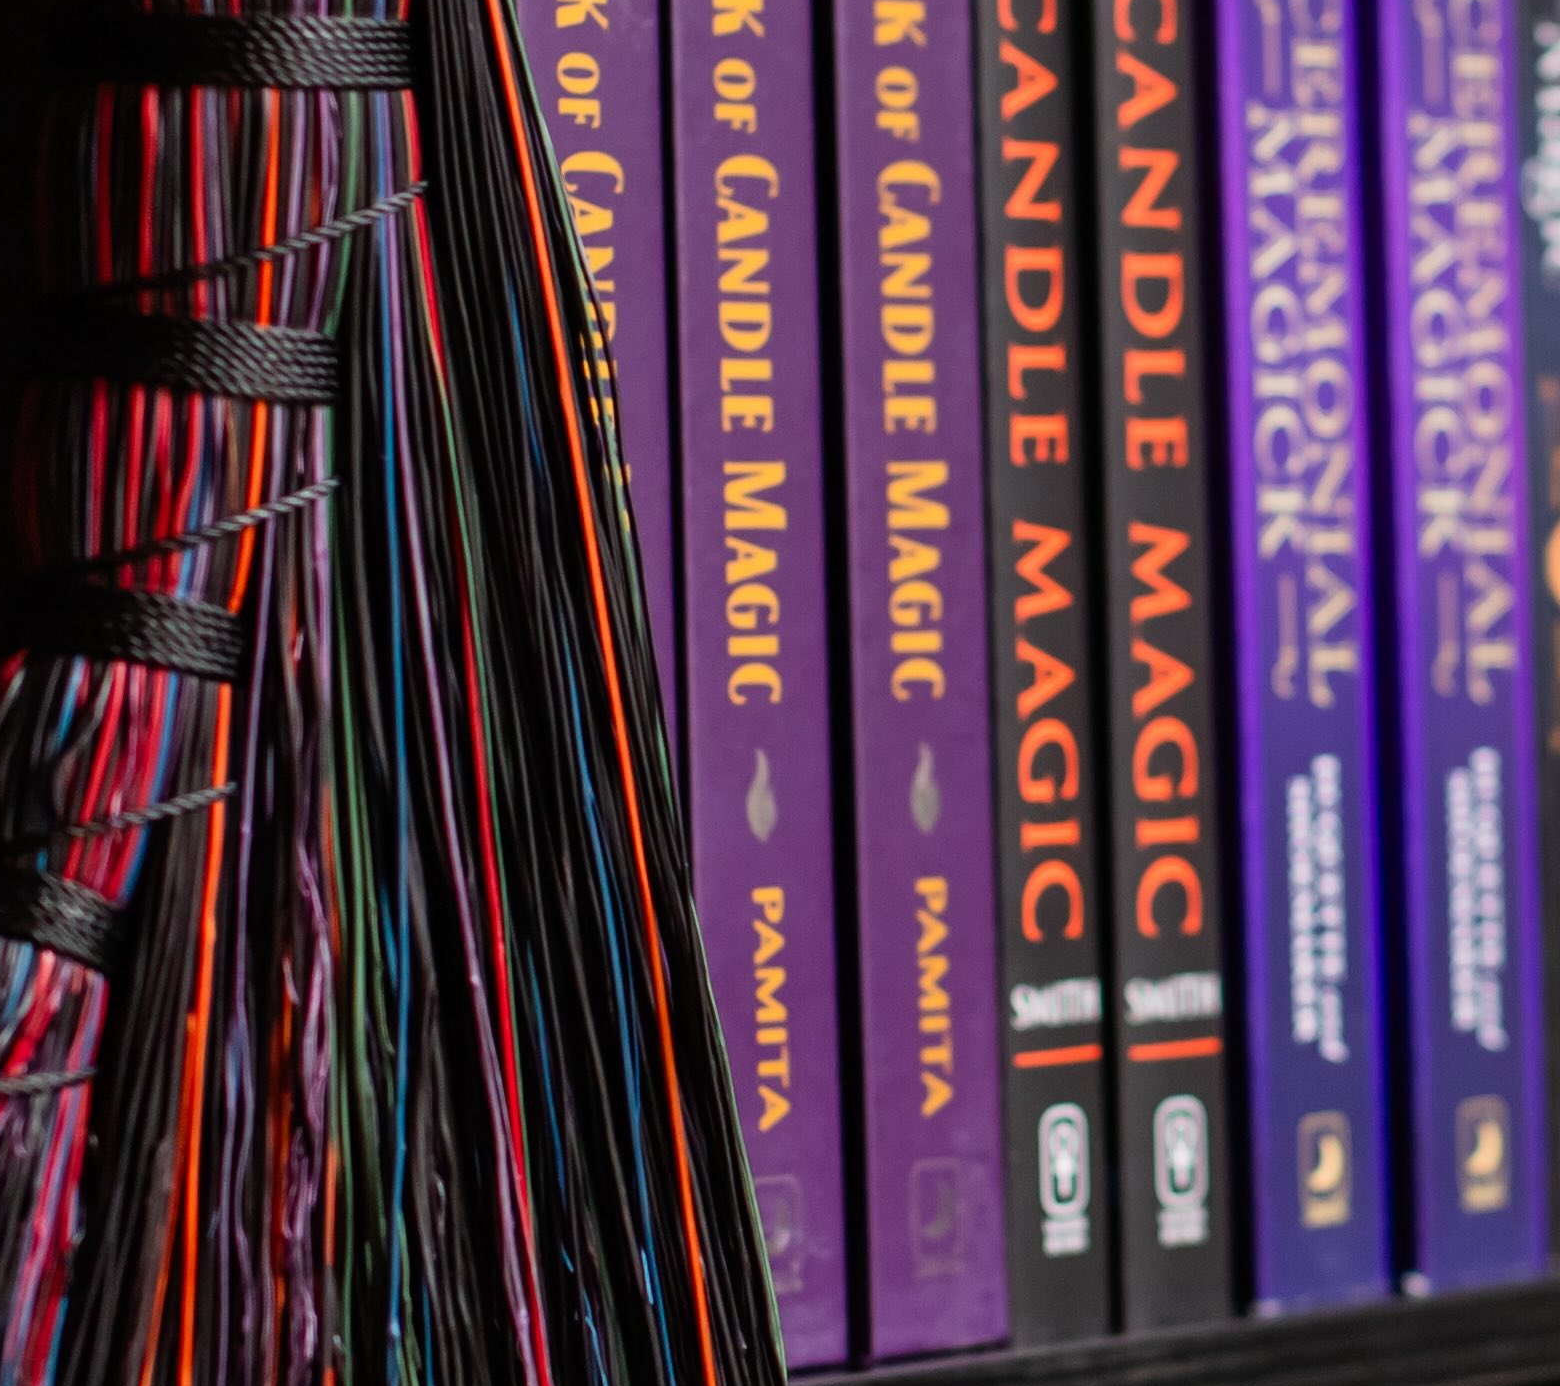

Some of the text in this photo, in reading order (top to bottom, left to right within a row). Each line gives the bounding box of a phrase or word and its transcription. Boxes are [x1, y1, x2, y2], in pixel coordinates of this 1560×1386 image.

[556, 52, 602, 127] OF
[714, 58, 758, 133] OF
[877, 67, 920, 138] OF
[715, 154, 780, 434] CANDLE
[877, 160, 941, 434] CANDLE
[1244, 100, 1308, 560] MAGICK
[1404, 110, 1471, 557] MAGICK
[723, 461, 788, 706] MAGIC
[885, 460, 950, 701] MAGIC
[1011, 519, 1087, 943] MAGIC
[1127, 521, 1204, 939] MAGIC
[751, 886, 791, 1132] PAMITA
[915, 877, 954, 1118] PAMITA
[1009, 976, 1102, 1031] SMITH
[1123, 971, 1223, 1025] SMITH
